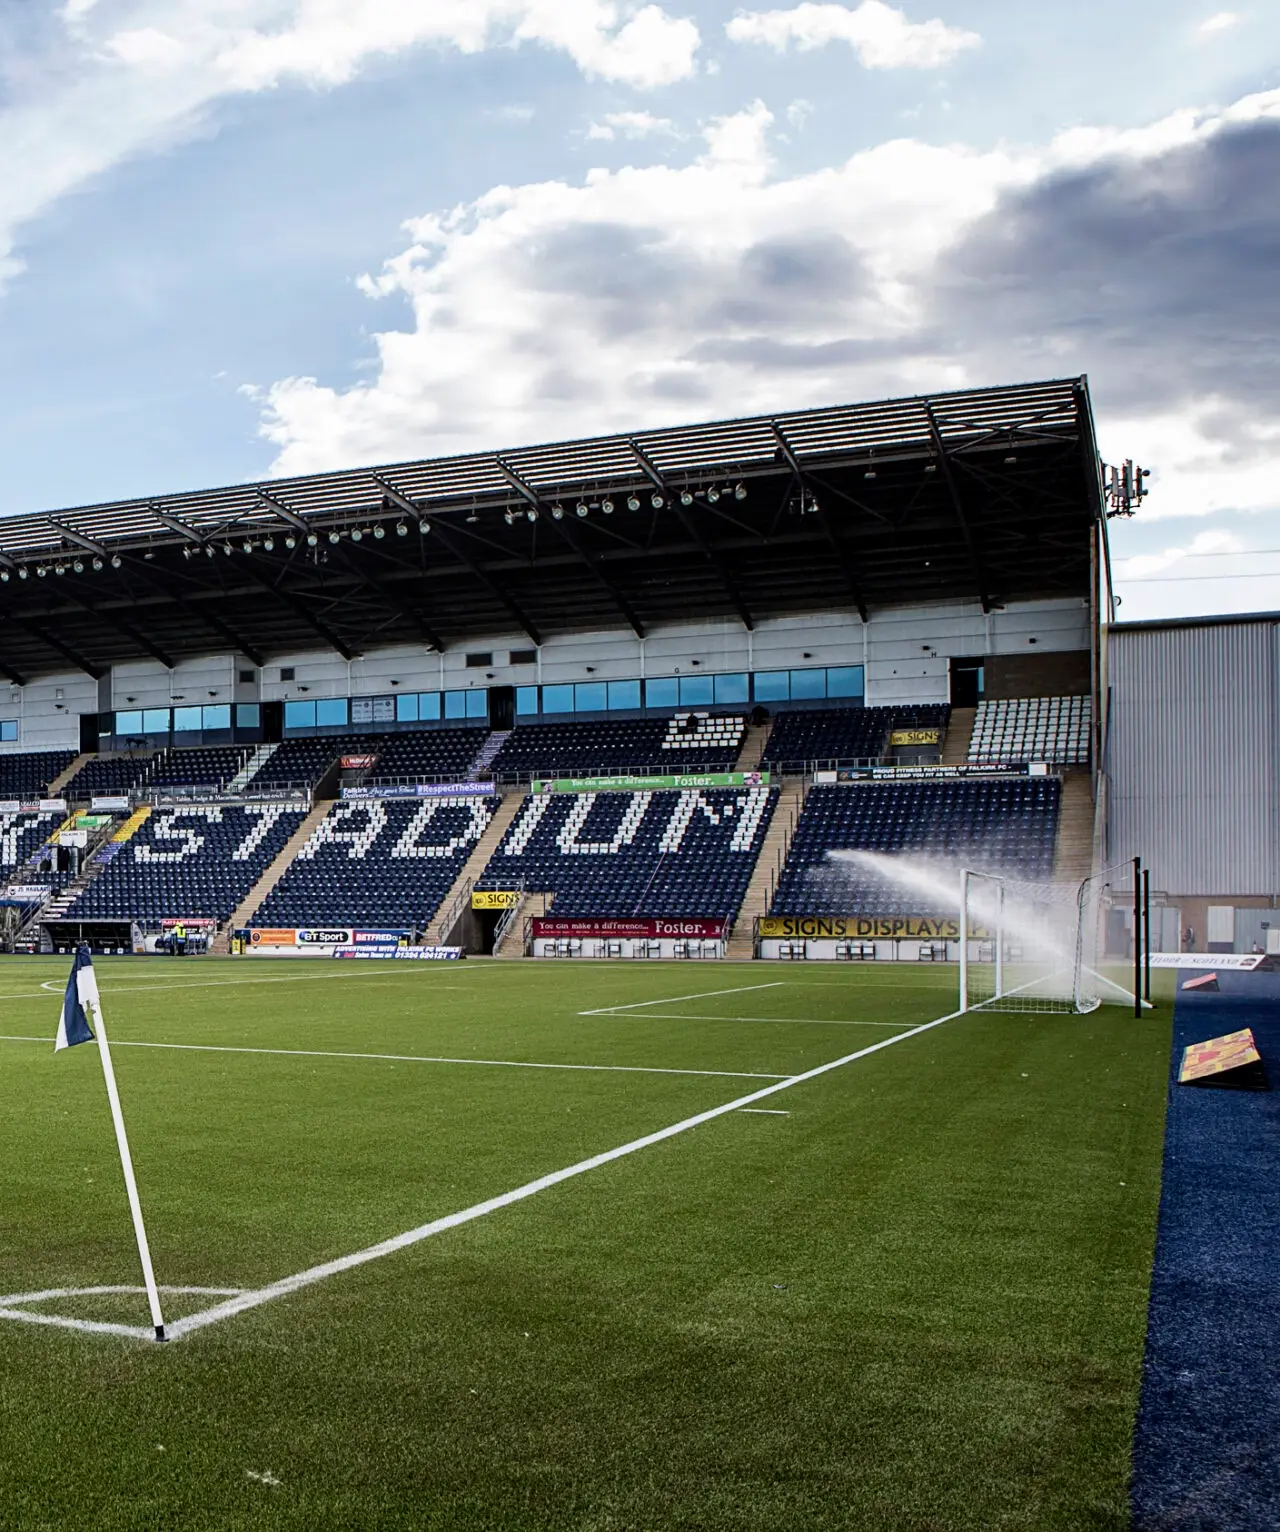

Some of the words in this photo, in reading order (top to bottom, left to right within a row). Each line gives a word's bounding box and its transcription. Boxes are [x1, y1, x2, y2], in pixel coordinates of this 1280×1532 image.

[673, 775, 715, 786] Foster.
[418, 784, 495, 794] #RespectTheStreet
[134, 787, 770, 863] STADIUM
[538, 921, 553, 930] You
[571, 922, 591, 930] make
[655, 920, 706, 934] Foster.
[783, 917, 846, 936] SIGNS
[857, 917, 958, 936] DISPLAYS
[304, 932, 318, 940] BT
[320, 932, 344, 942] Sport
[356, 933, 392, 941] BETFRED
